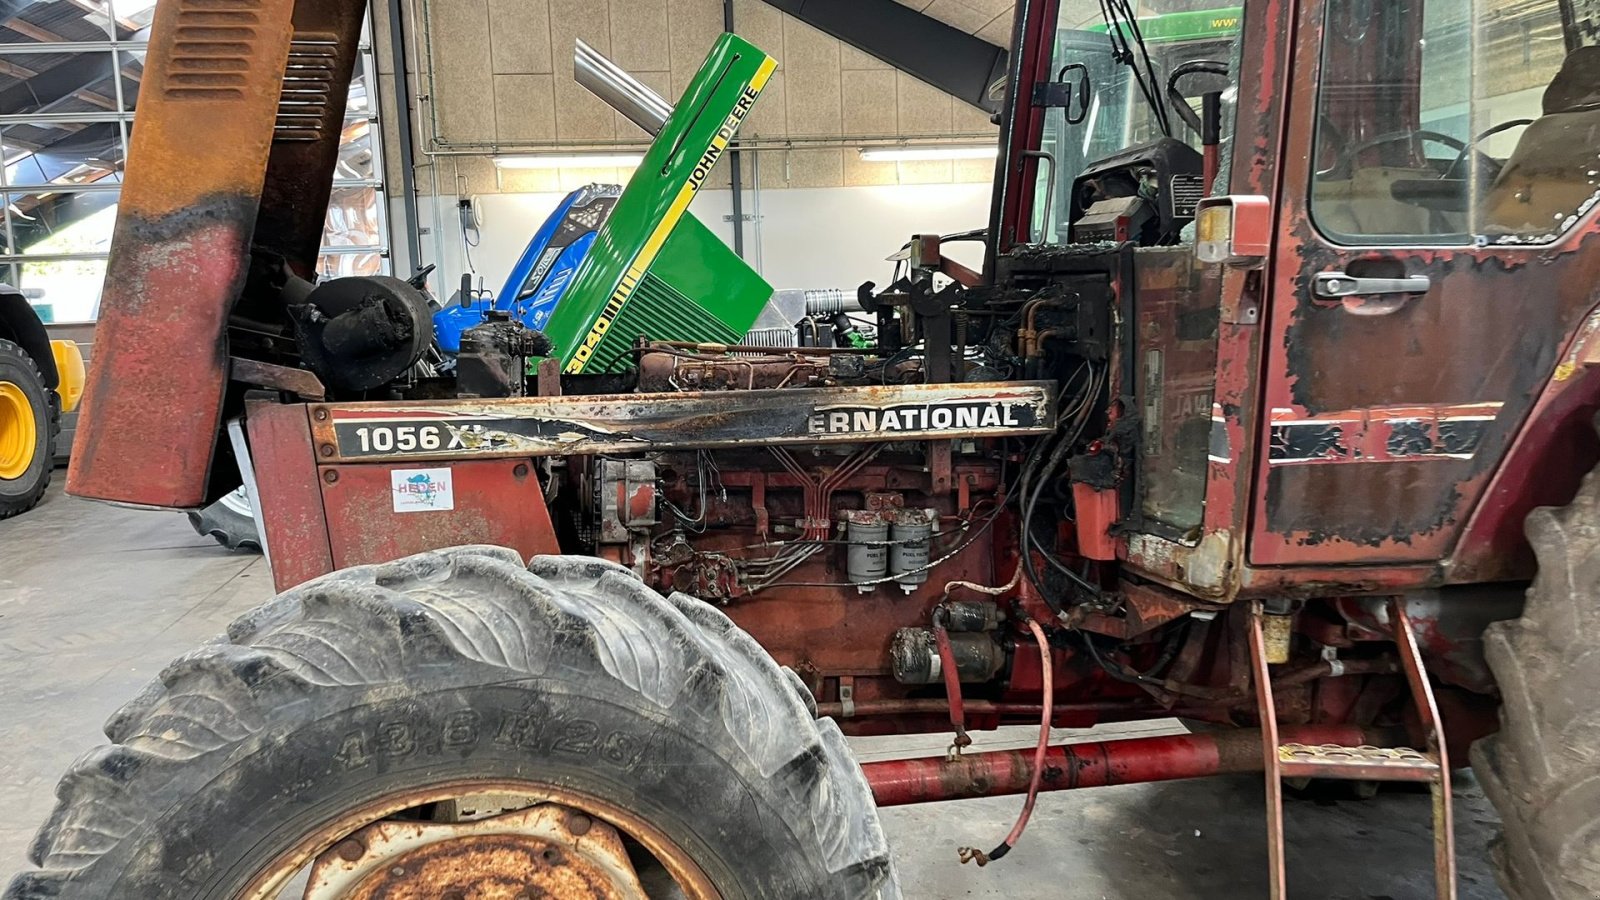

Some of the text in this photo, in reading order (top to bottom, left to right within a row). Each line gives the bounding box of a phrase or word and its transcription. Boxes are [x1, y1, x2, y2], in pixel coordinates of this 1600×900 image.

[687, 84, 759, 191] JOHN DEERE
[563, 318, 607, 374] 3040
[355, 426, 440, 451] 1056
